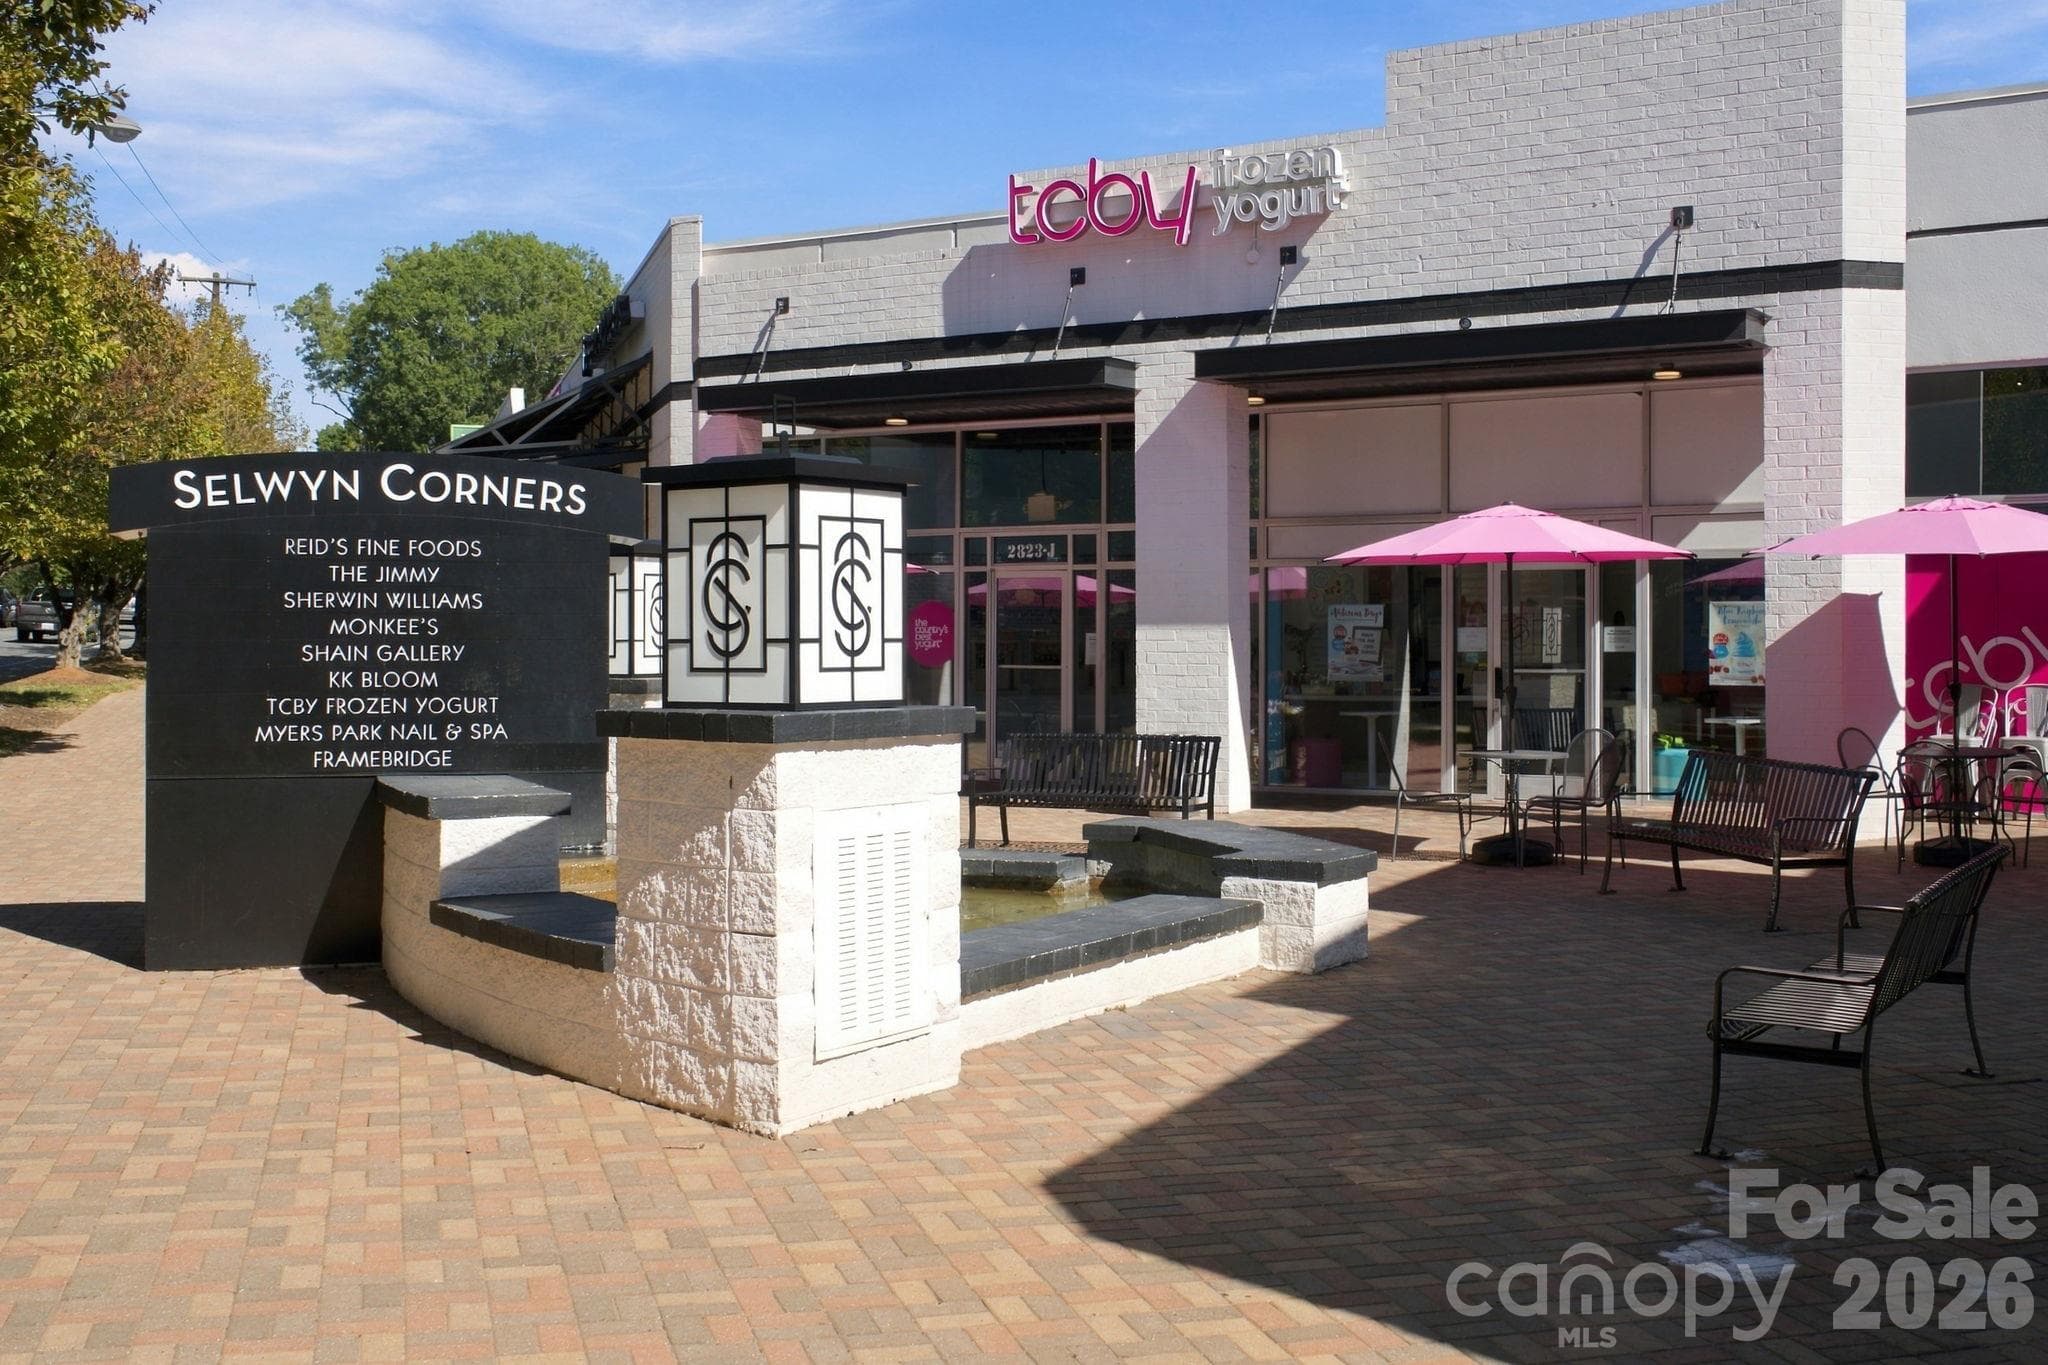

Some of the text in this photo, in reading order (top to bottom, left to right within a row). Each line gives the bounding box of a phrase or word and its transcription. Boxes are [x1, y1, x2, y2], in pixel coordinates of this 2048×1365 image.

[1211, 147, 1342, 188] frozen
[1008, 157, 1197, 246] tcby
[1212, 178, 1344, 236] yogurt
[172, 463, 587, 516] SELWYN CORNERS
[285, 538, 482, 557] REID'S FINE FOODS
[1007, 542, 1056, 559] 2823-J
[328, 565, 440, 583] THE JIMMY
[284, 591, 483, 610] SHERWIN WILLIAMS
[329, 617, 439, 636] MONKEE'S
[301, 644, 465, 662] SHAIN GALLERY
[329, 670, 439, 689] KK BLOOM
[266, 696, 499, 715] TCBY FROZEN YOGURT
[254, 722, 509, 743] MYERS PARK NAIL & SPA
[313, 749, 453, 768] FRAMEBRIDGE
